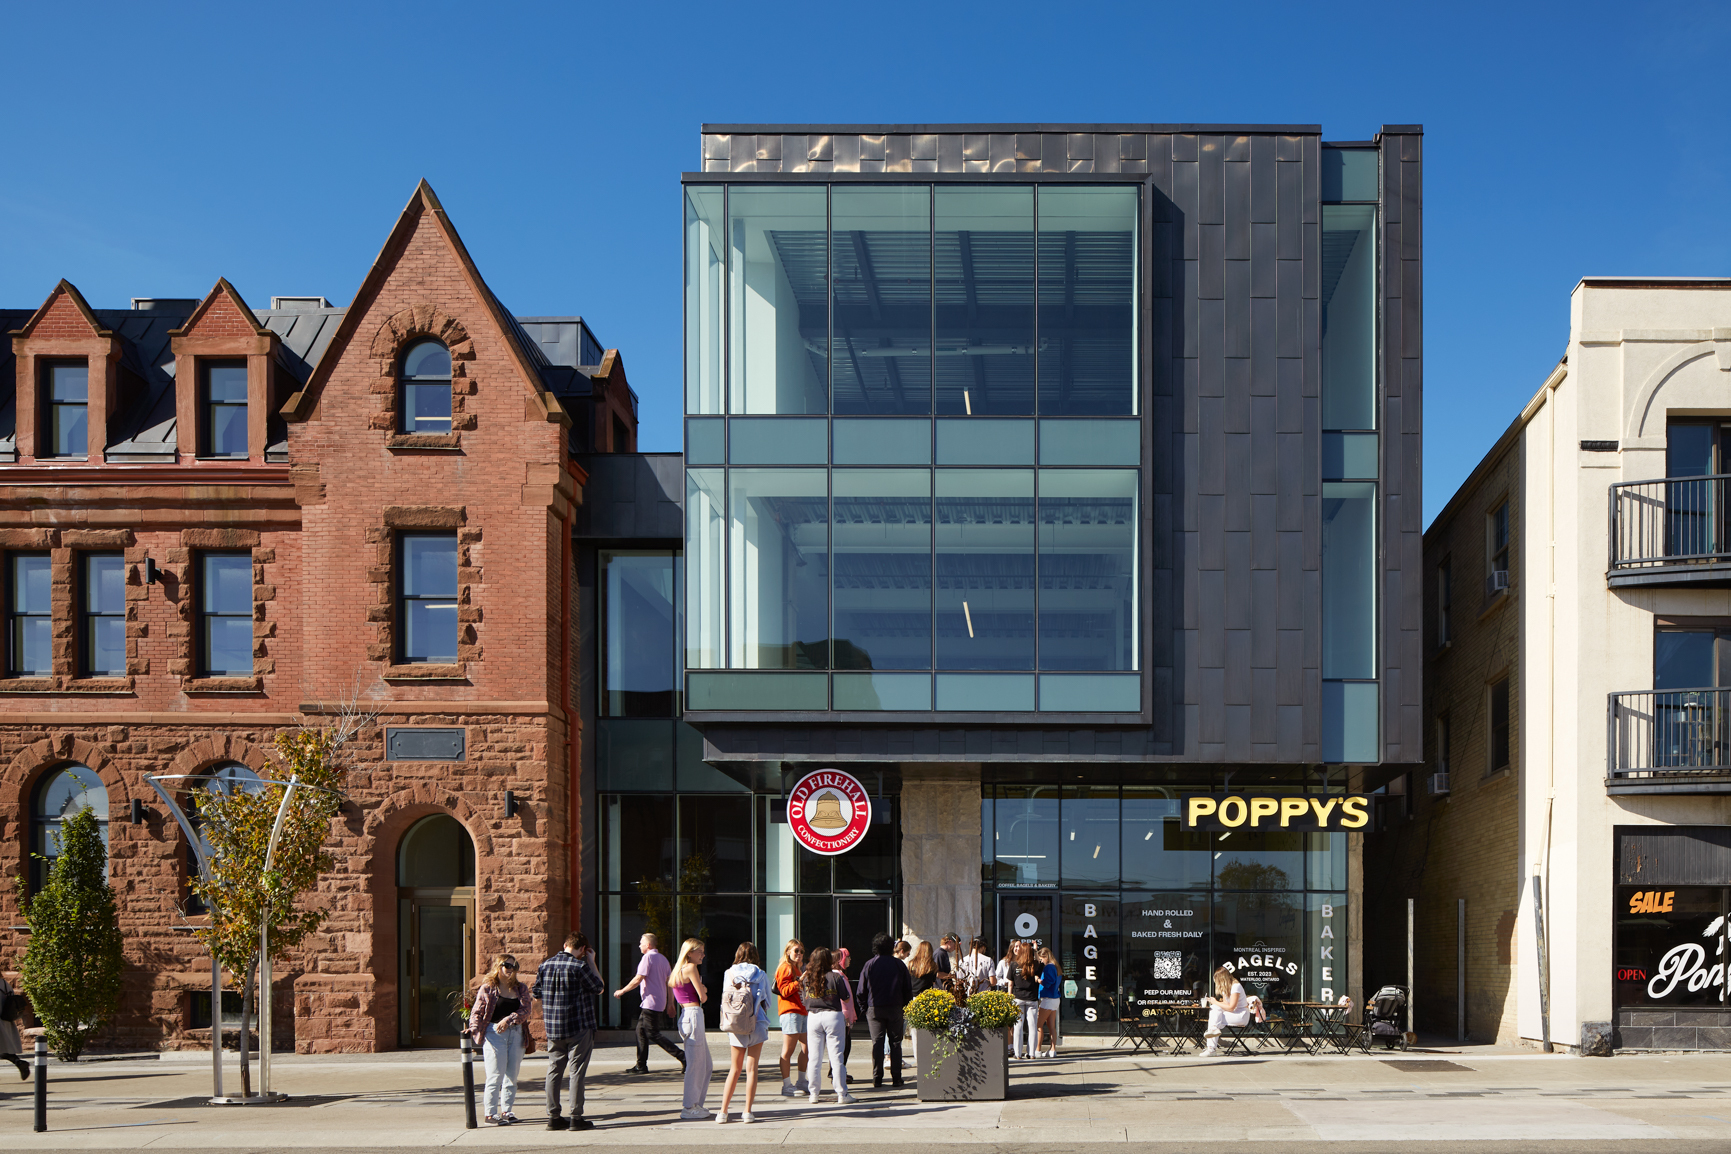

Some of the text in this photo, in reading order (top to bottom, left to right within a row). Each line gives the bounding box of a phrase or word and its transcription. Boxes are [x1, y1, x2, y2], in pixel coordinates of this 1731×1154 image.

[791, 773, 866, 820] OLD FIREHALL
[1188, 795, 1369, 828] POPPY'S
[797, 825, 859, 849] CONFECTIONERY
[1629, 890, 1675, 914] SALE
[1163, 919, 1172, 928] &
[1083, 903, 1098, 1022] BAGELS
[1222, 954, 1298, 975] BAGELS
[1617, 969, 1646, 981] OPEN
